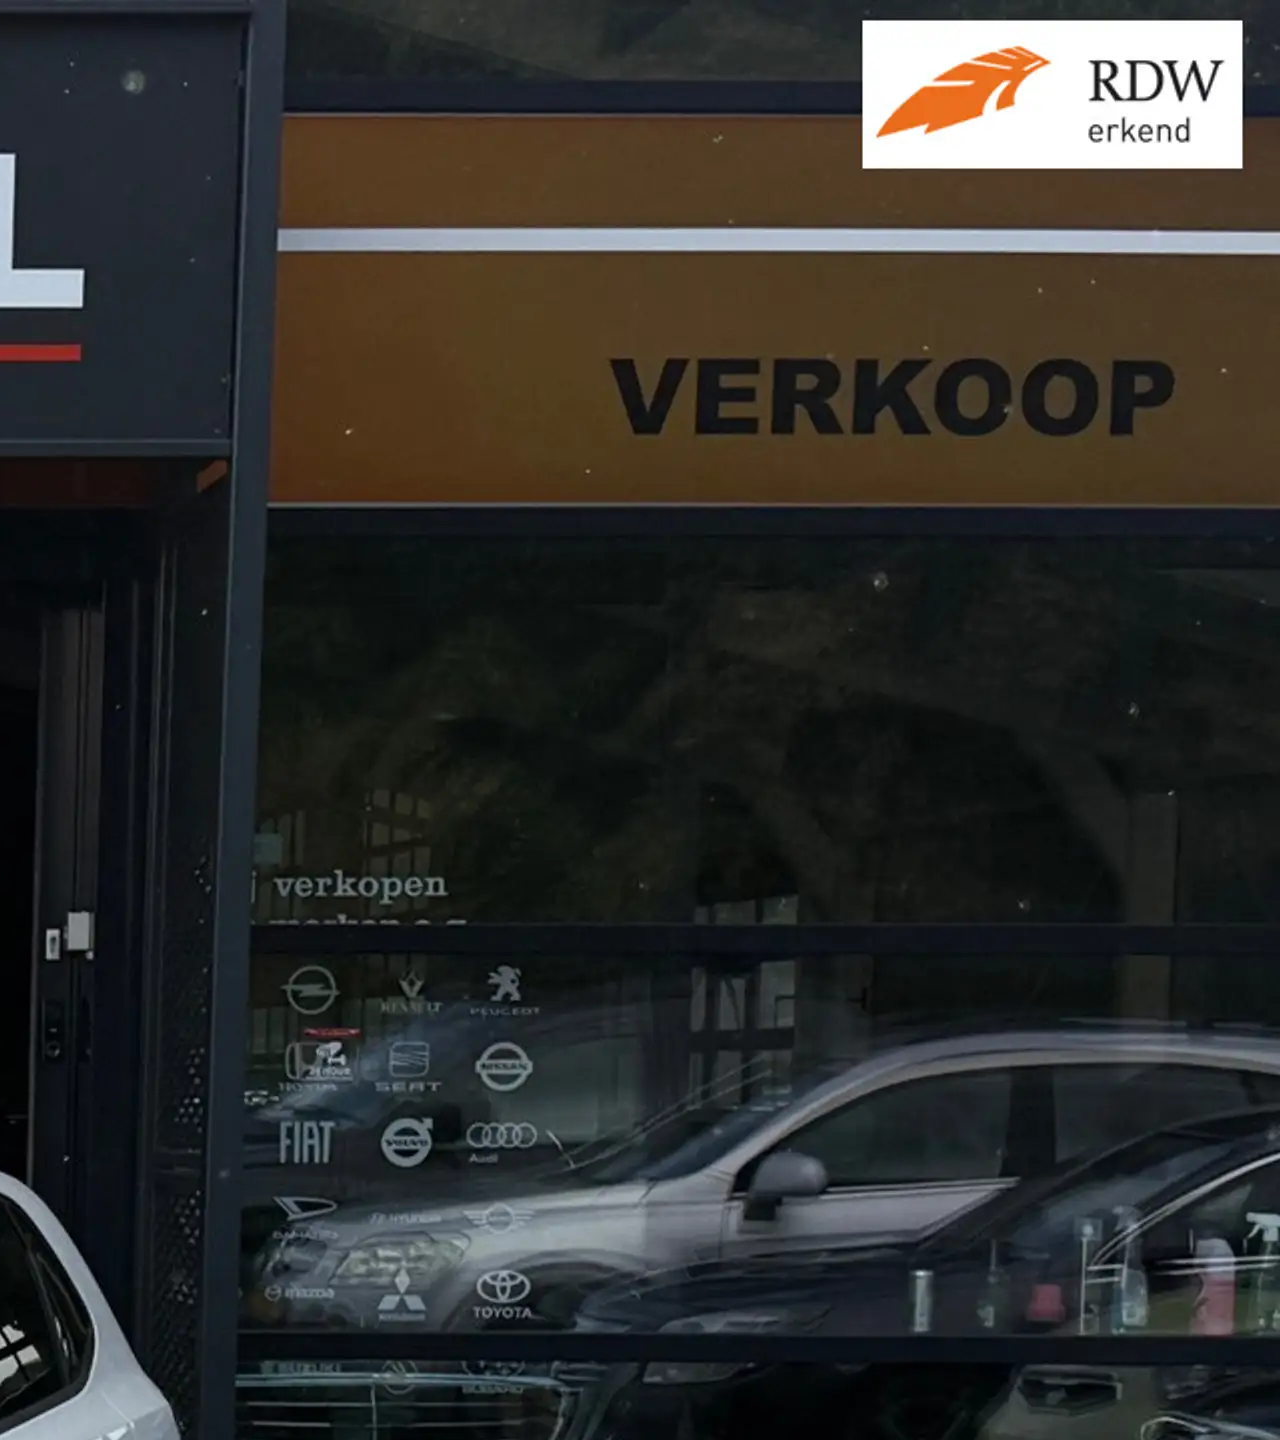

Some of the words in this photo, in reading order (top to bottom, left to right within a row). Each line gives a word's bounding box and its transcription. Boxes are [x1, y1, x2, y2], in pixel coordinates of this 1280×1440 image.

[610, 357, 1176, 437] VERKOOP
[274, 869, 449, 905] verkopen
[374, 1081, 442, 1092] SEAT
[278, 1120, 337, 1165] FIAT
[468, 1153, 499, 1164] Audi
[472, 1306, 533, 1320] TOYOTA
